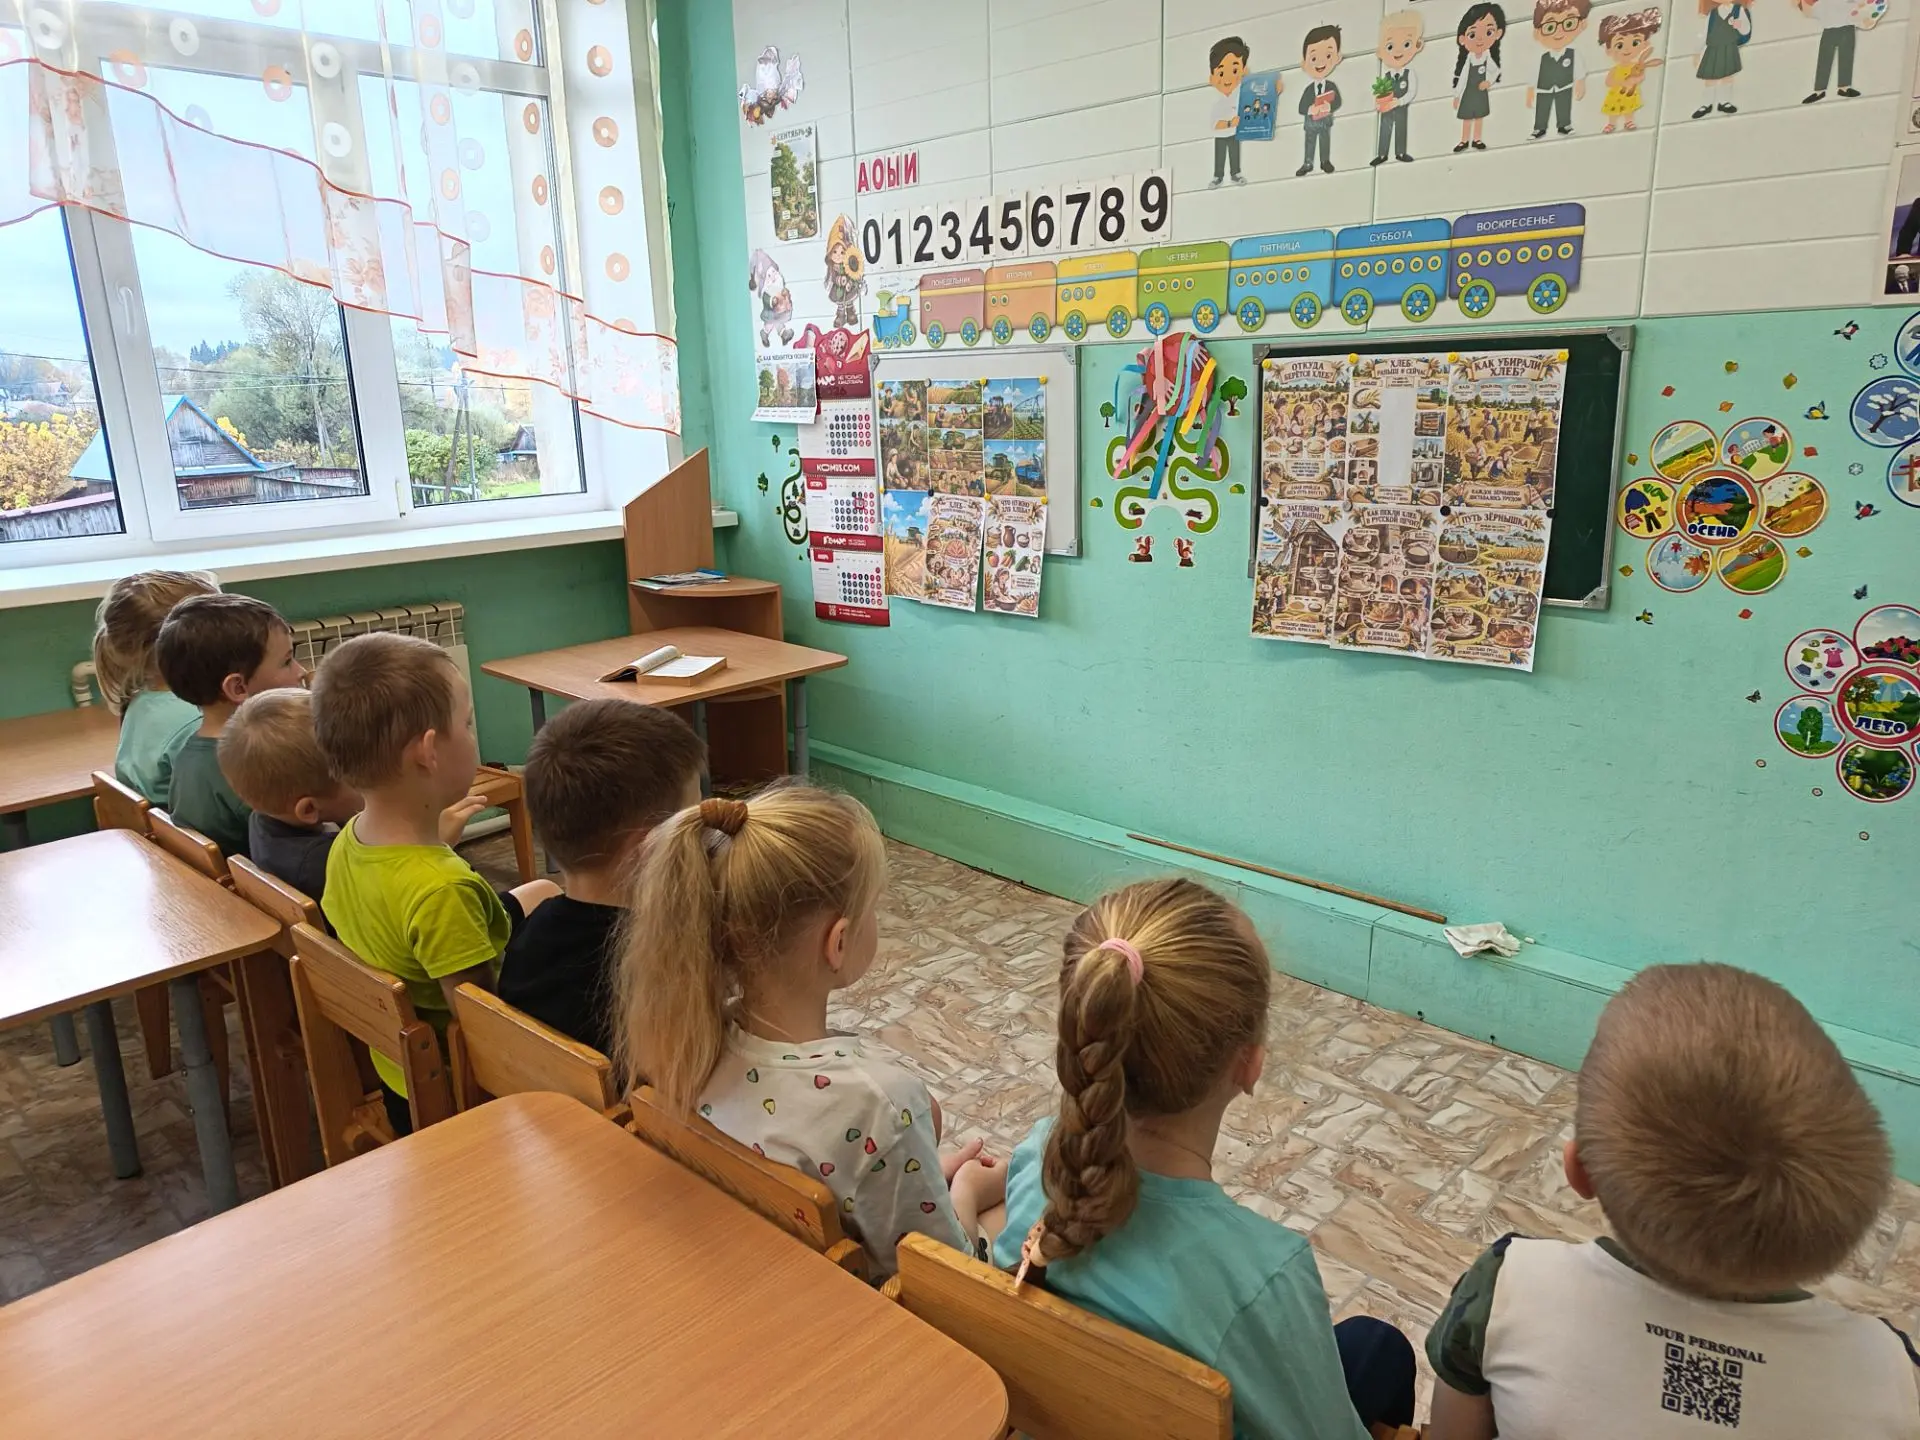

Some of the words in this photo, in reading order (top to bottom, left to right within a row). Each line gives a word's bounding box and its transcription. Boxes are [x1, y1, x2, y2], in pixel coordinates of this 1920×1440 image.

[1477, 215, 1556, 231] ВОСКРЕСЕНЬЕ
[1369, 230, 1413, 242] СУББОТА
[1259, 240, 1301, 253] ПЯТНИЦА
[1166, 252, 1198, 262] ЧЕТВЕРГ
[1292, 361, 1324, 371] ОТКУДА
[1474, 358, 1494, 371] КАК
[1498, 357, 1542, 370] УБИРАЛИ
[1490, 366, 1525, 377] ХЛЕБ?
[1461, 512, 1482, 524] ПУТЬ
[1484, 511, 1528, 528] ЗЁРНЫШКА
[1687, 522, 1738, 538] ОСЕНЬ
[1855, 716, 1907, 734] ЛЕТО
[1645, 1322, 1686, 1343] YOUR
[1688, 1335, 1767, 1364] PERSONAL
